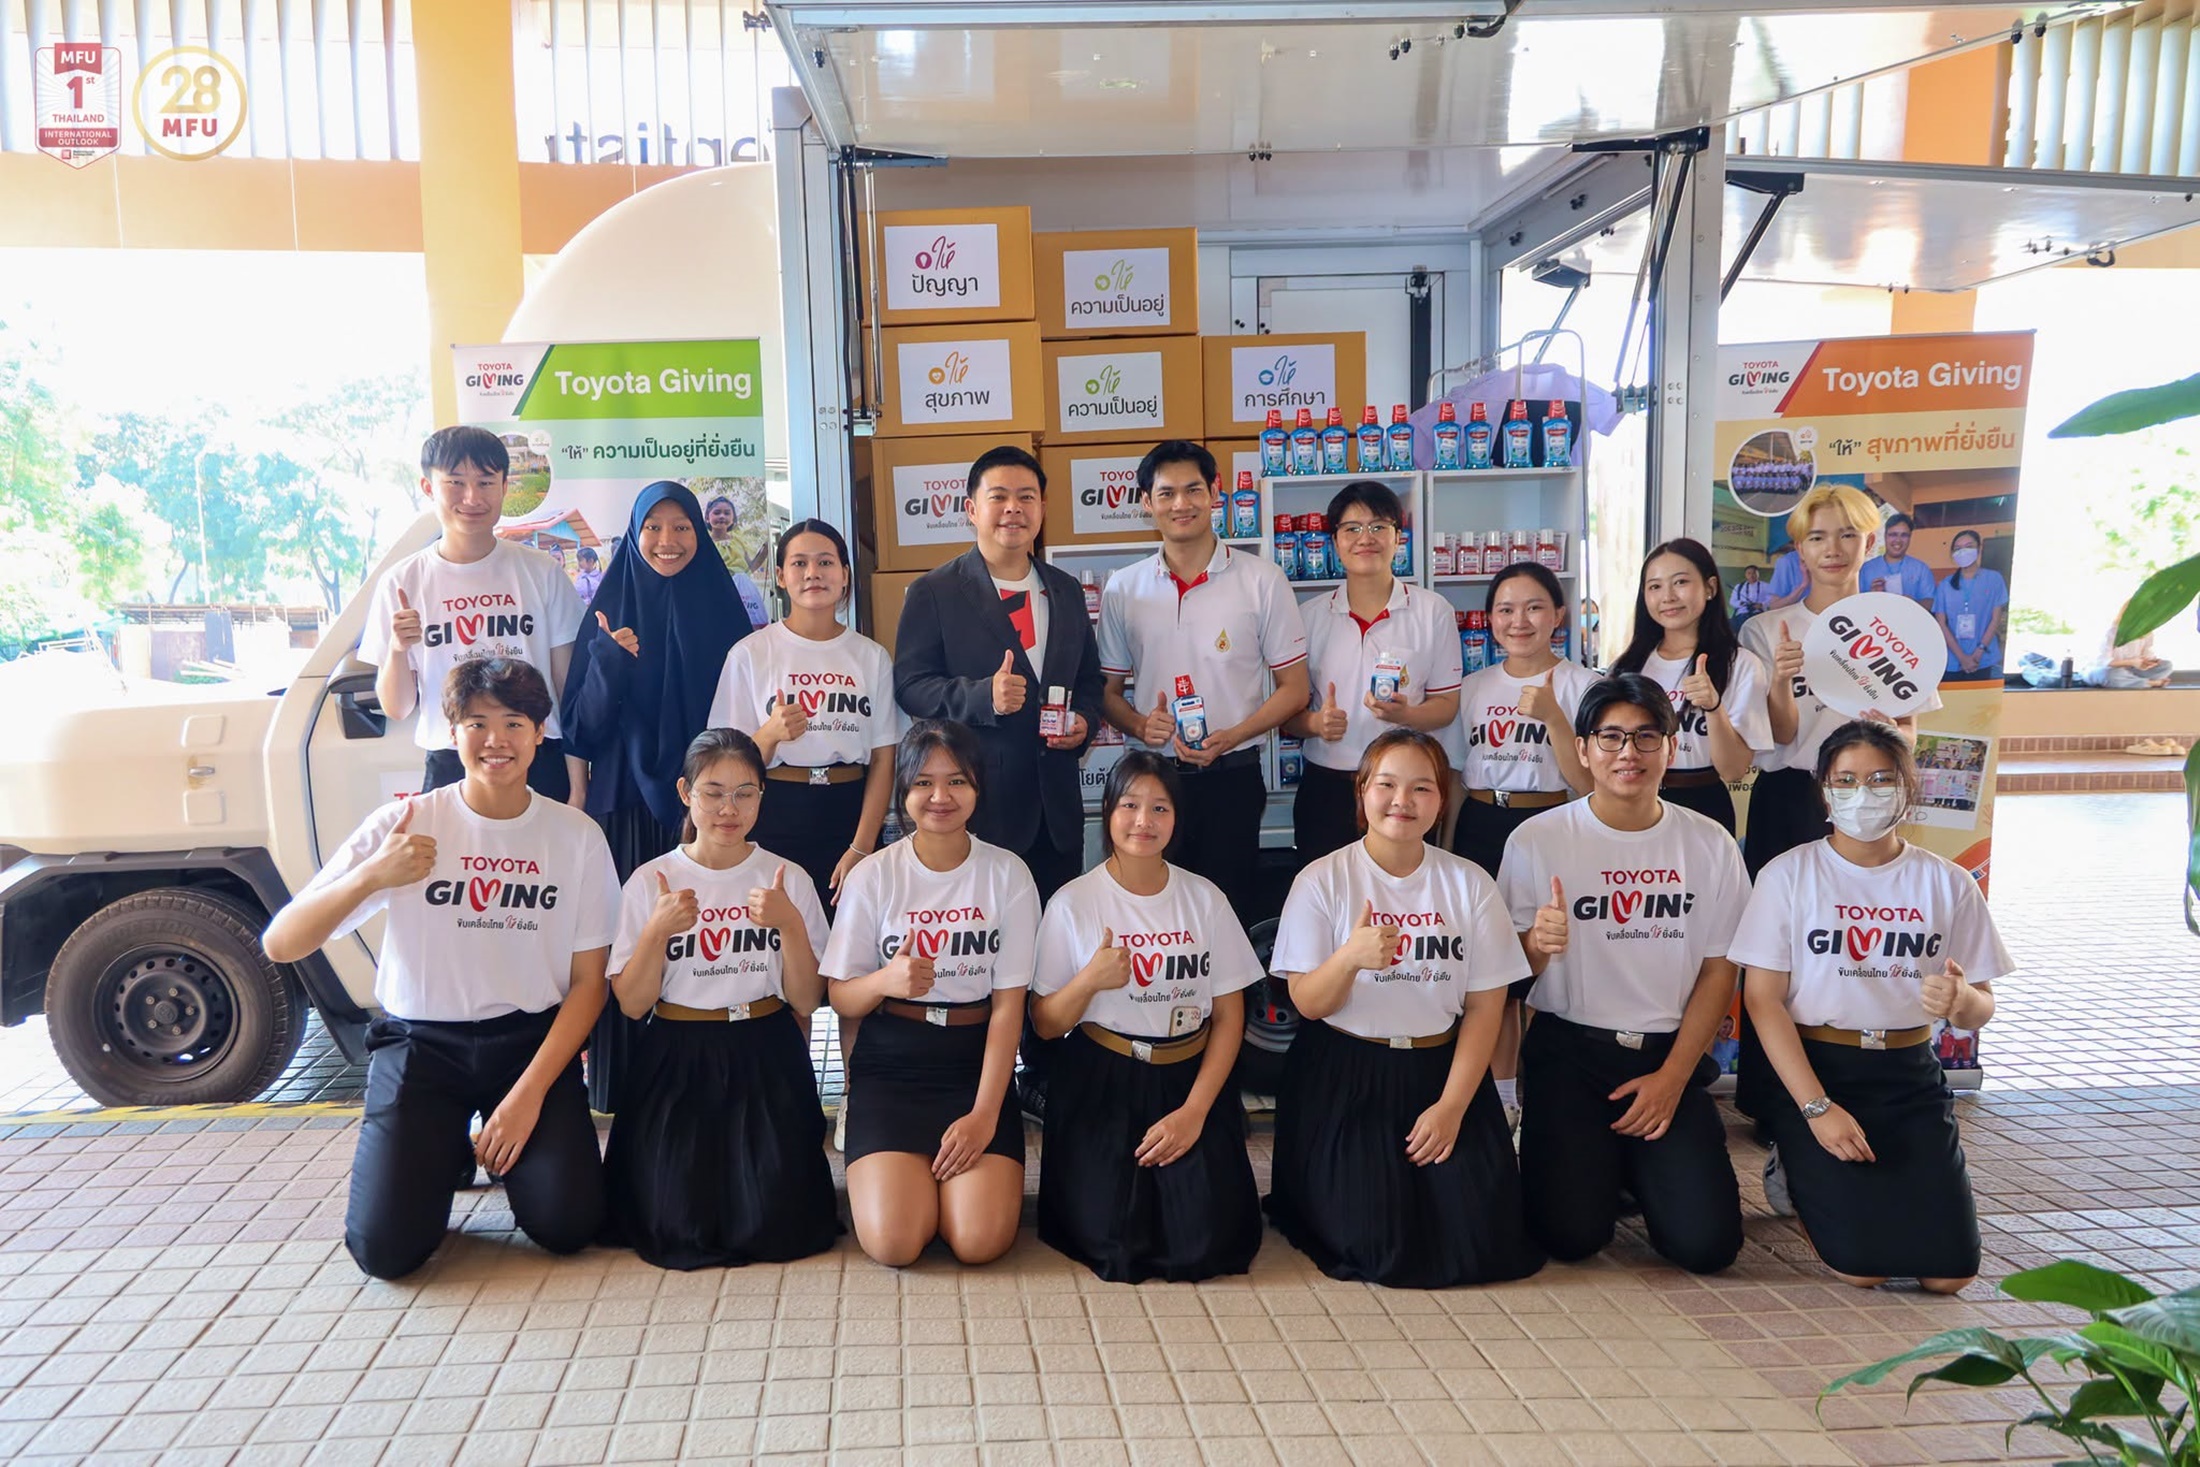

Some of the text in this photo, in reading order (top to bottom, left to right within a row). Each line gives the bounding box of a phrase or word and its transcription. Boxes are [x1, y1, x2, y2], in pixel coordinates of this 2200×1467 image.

[911, 273, 978, 296] ปัญญา
[1070, 294, 1164, 318] ความเป็นอยู่
[478, 363, 512, 371] TOYOTA
[1743, 361, 1779, 369] TOYOTA
[466, 373, 524, 389] GIVING
[555, 368, 752, 400] Toyota Giving
[1728, 371, 1790, 387] GIVING
[1823, 361, 2022, 397] Toyota Giving
[925, 389, 989, 413] สุขภาพ
[1243, 384, 1325, 407] การศึกษา
[1068, 396, 1157, 420] ความเป็นอยู่
[593, 433, 755, 465] ความเป็นอยู่ที่ยั่งยืน
[1867, 422, 2015, 461] สุขภาพที่ยั่งยืน
[924, 479, 967, 491] TOYOT
[1100, 470, 1138, 482] TOYO
[443, 594, 516, 612] TOYOTA
[424, 613, 534, 647] GIVING
[1868, 616, 1920, 670] TOYOTA
[1828, 615, 1919, 701] GIVING
[788, 672, 856, 687] TOYOTA
[460, 856, 540, 875] TOYOTA
[1600, 869, 1681, 885] TOYOTA
[425, 876, 558, 912] GIVING
[697, 906, 750, 922] OYOT
[906, 907, 985, 924] TOYOTA
[1371, 911, 1446, 928] TOYOTA
[1834, 904, 1924, 922] TOYOTA
[1119, 930, 1194, 948] TOYOTA
[1807, 925, 1942, 961] GIVING
[1132, 951, 1210, 988] VING
